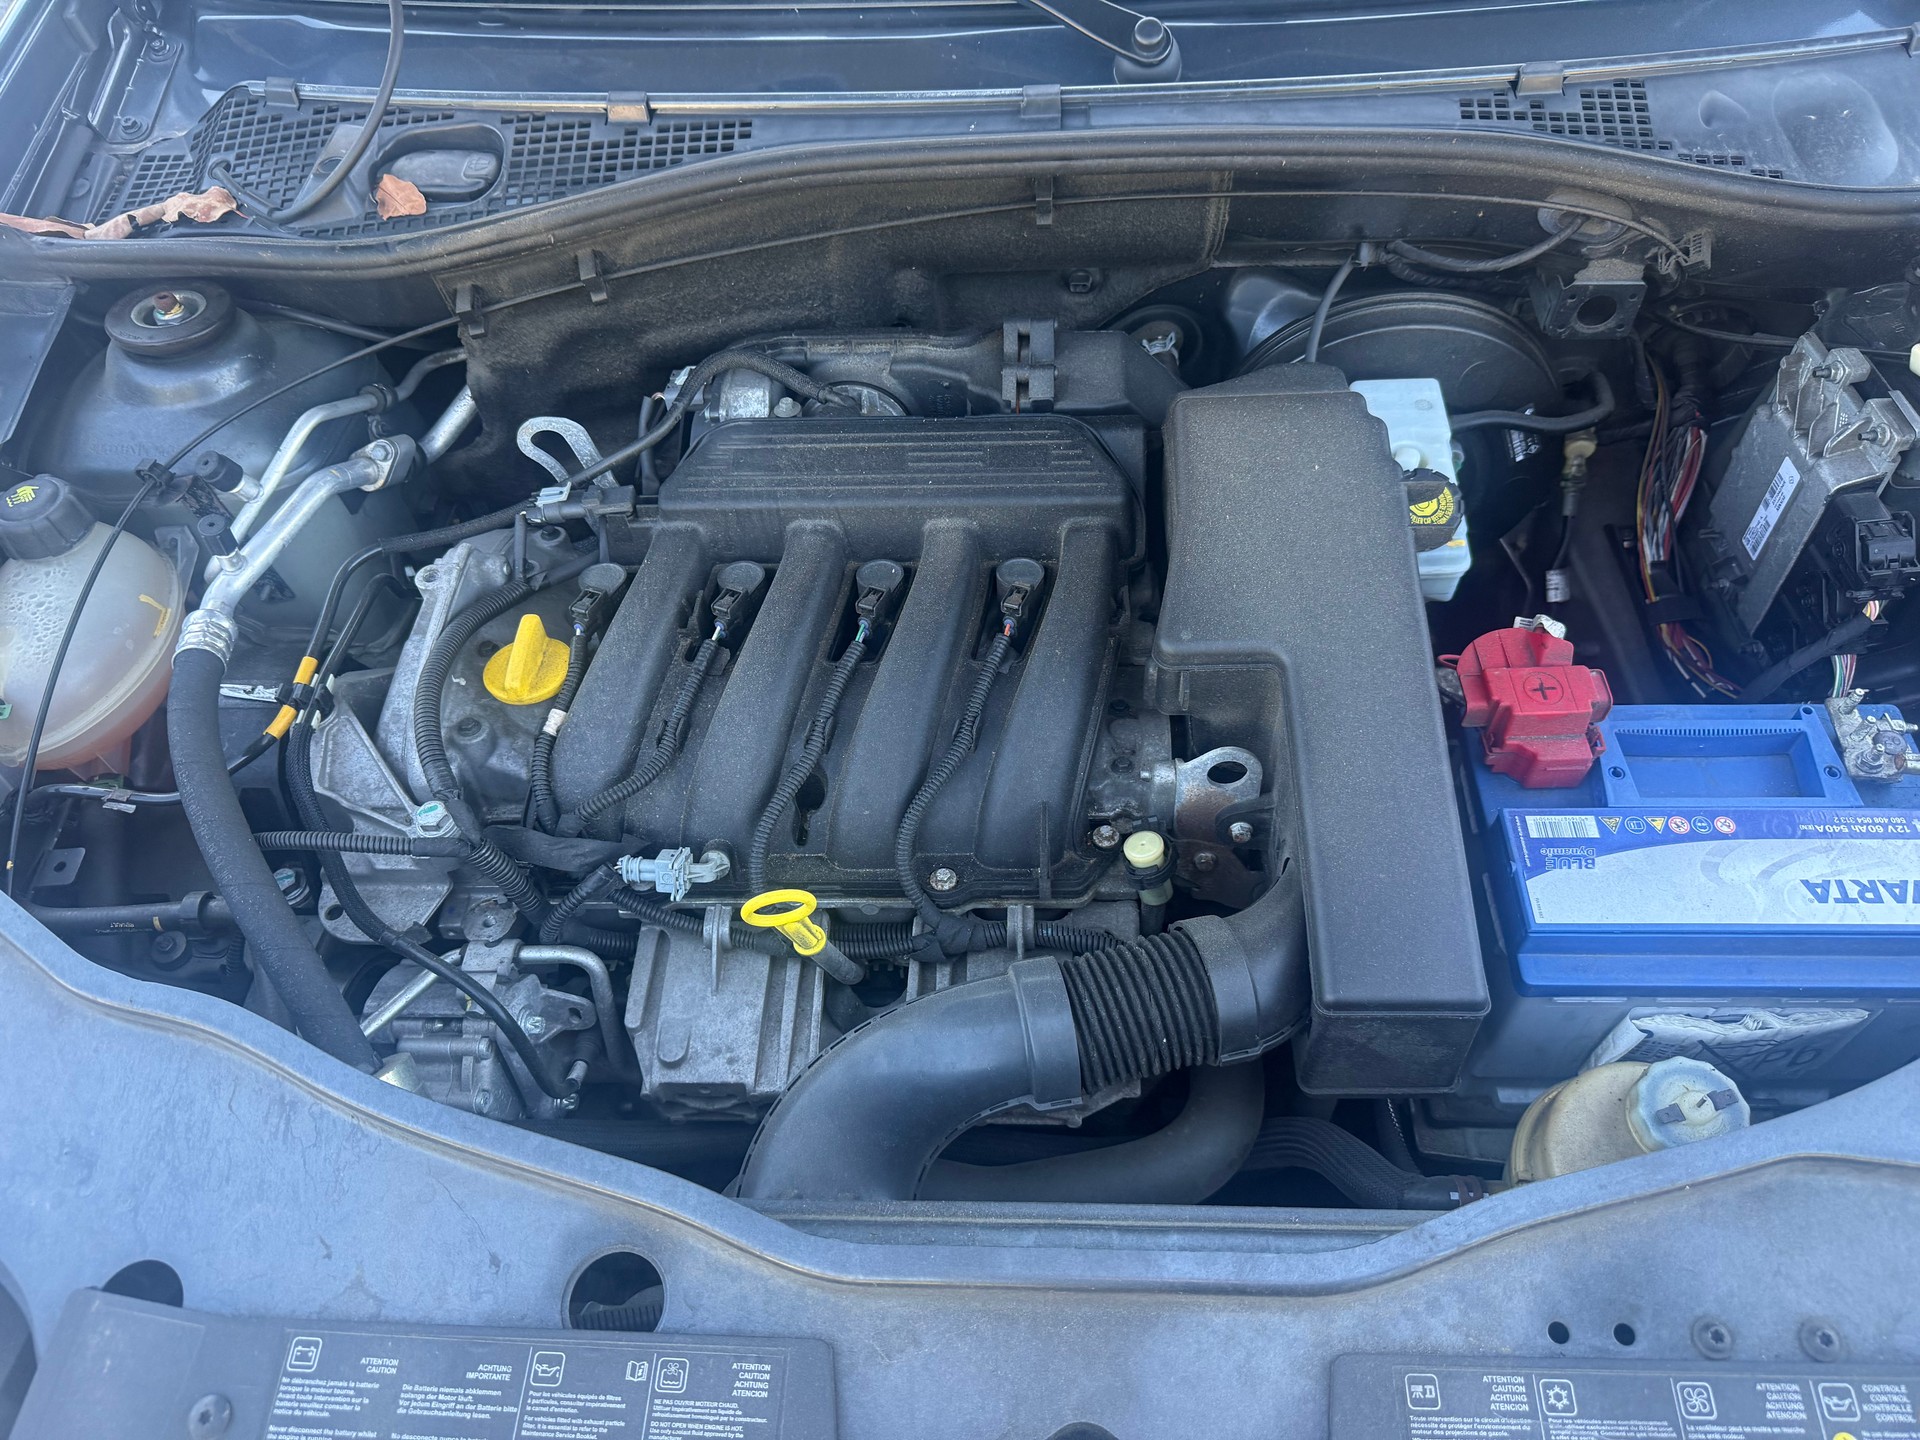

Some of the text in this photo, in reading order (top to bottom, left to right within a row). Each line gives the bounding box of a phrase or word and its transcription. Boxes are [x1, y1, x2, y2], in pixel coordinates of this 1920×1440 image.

[1541, 846, 1596, 857] Dynamic
[1545, 857, 1596, 870] BLUE
[366, 1366, 397, 1374] CAUTION
[478, 1364, 512, 1372] ACHTUNG
[732, 1363, 771, 1371] ATTENTION
[466, 1371, 511, 1380] IMPORTANTE
[1756, 1383, 1800, 1391] ATTENTION
[1862, 1385, 1907, 1393] CONTROLE
[313, 1394, 351, 1403] intervention
[1870, 1394, 1910, 1403] CONTROL
[431, 1401, 455, 1409] Eingriff
[1491, 1403, 1529, 1411] ATENCION
[1766, 1402, 1804, 1410] ACHTUNG
[1862, 1404, 1912, 1412] KONTROLLE
[408, 1408, 472, 1418] Gebrauchsanleitung
[1766, 1411, 1807, 1420] ATENCION
[1875, 1414, 1916, 1423] CONTROL
[335, 1430, 357, 1438] battery
